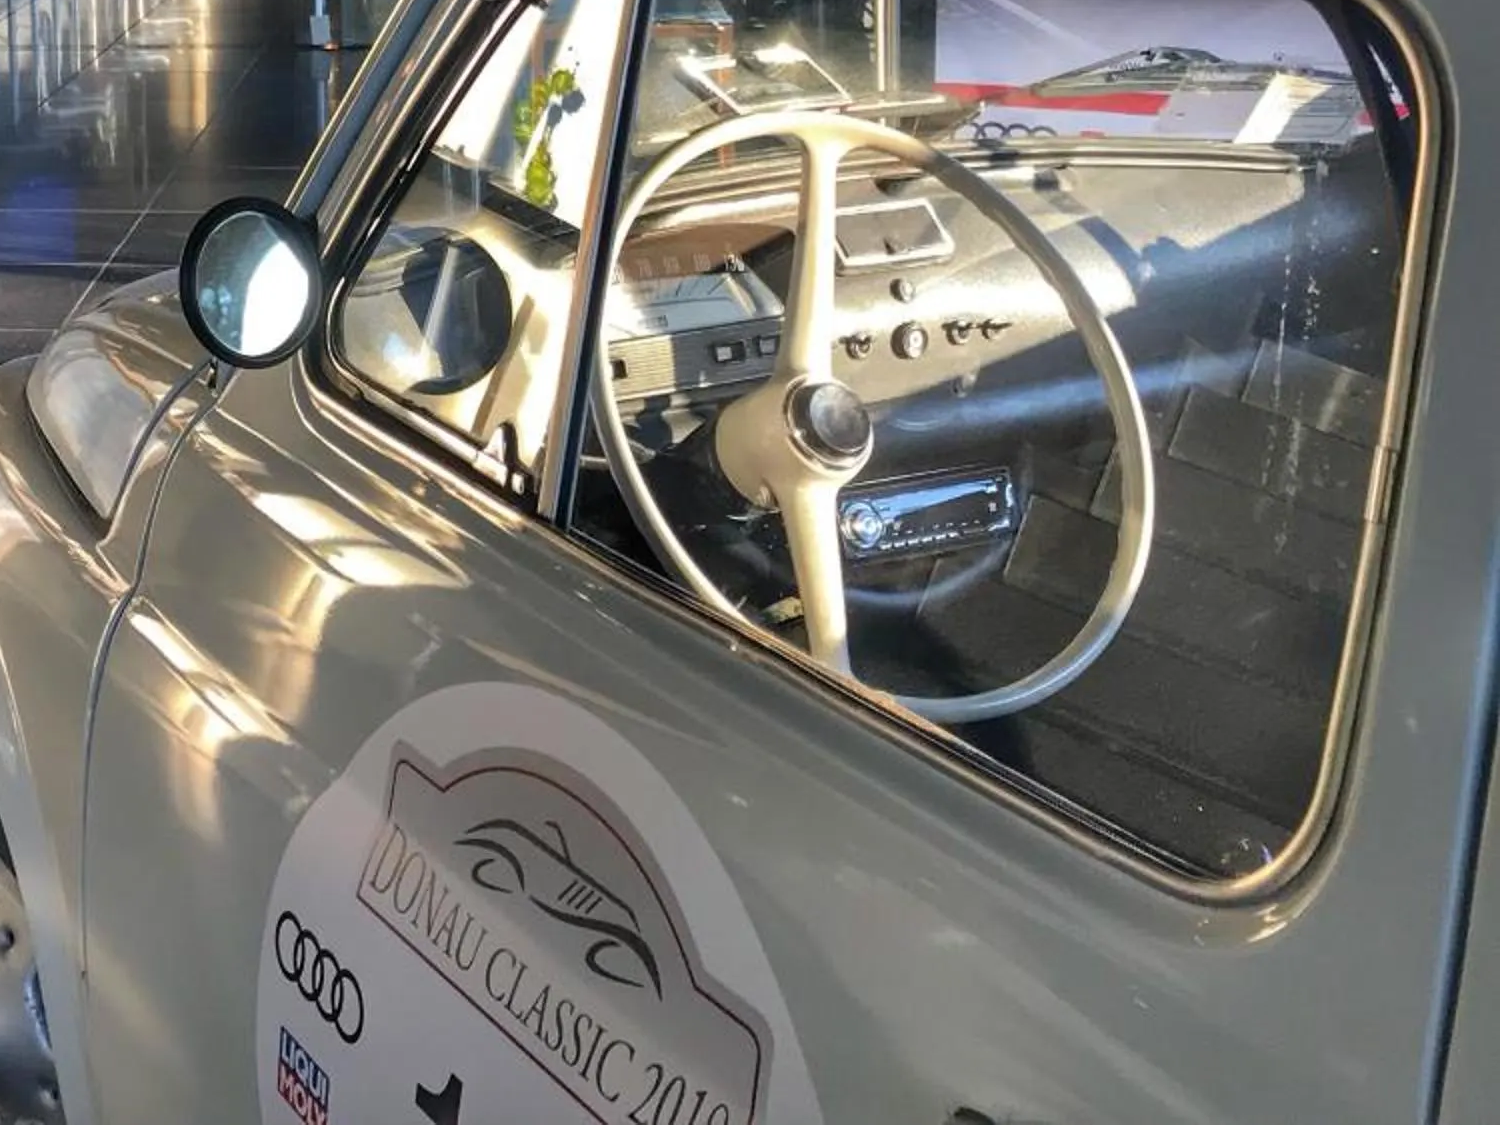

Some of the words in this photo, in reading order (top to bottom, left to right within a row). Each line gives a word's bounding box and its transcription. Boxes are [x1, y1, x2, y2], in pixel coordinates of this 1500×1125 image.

[369, 823, 488, 972] DONAU
[484, 947, 636, 1103] CLASSIC
[281, 1031, 327, 1106] LIQUI
